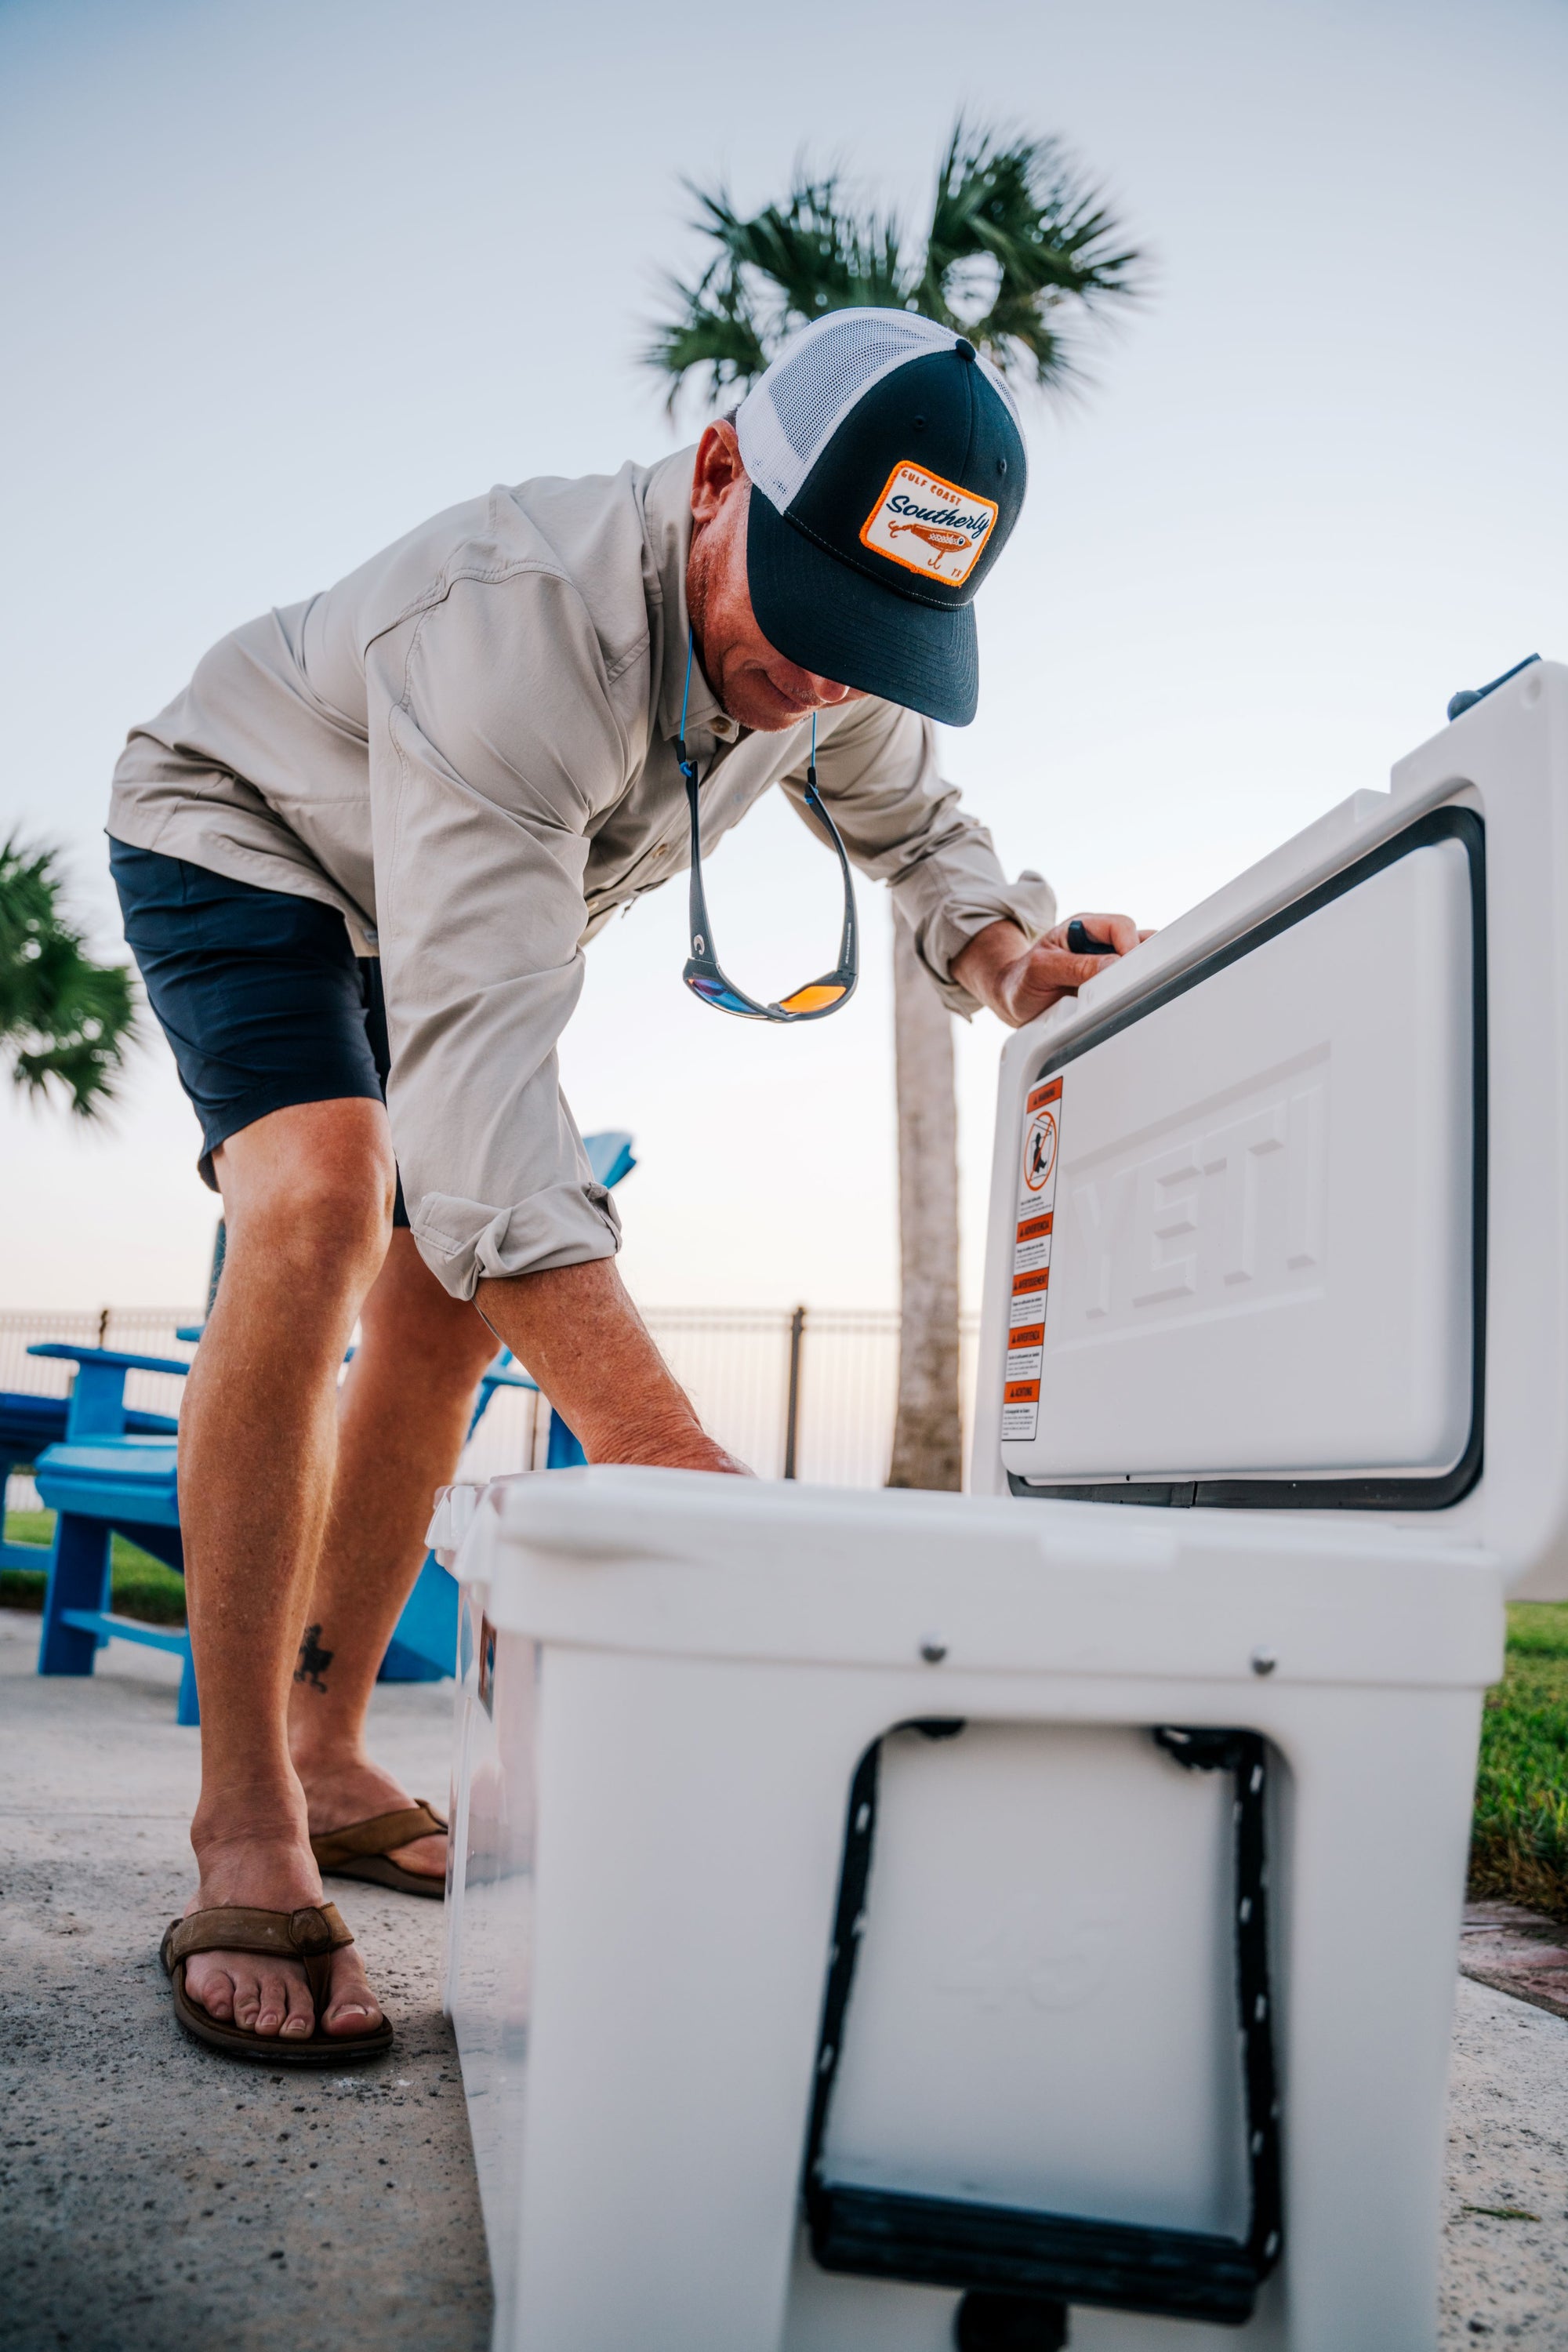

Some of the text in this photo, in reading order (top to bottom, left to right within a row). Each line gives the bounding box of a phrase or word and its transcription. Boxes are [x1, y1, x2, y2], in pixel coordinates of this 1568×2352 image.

[901, 470, 961, 506] GULF COAST
[886, 495, 989, 539] Southerly
[951, 568, 962, 578] TX
[1071, 1083, 1325, 1319] YETI
